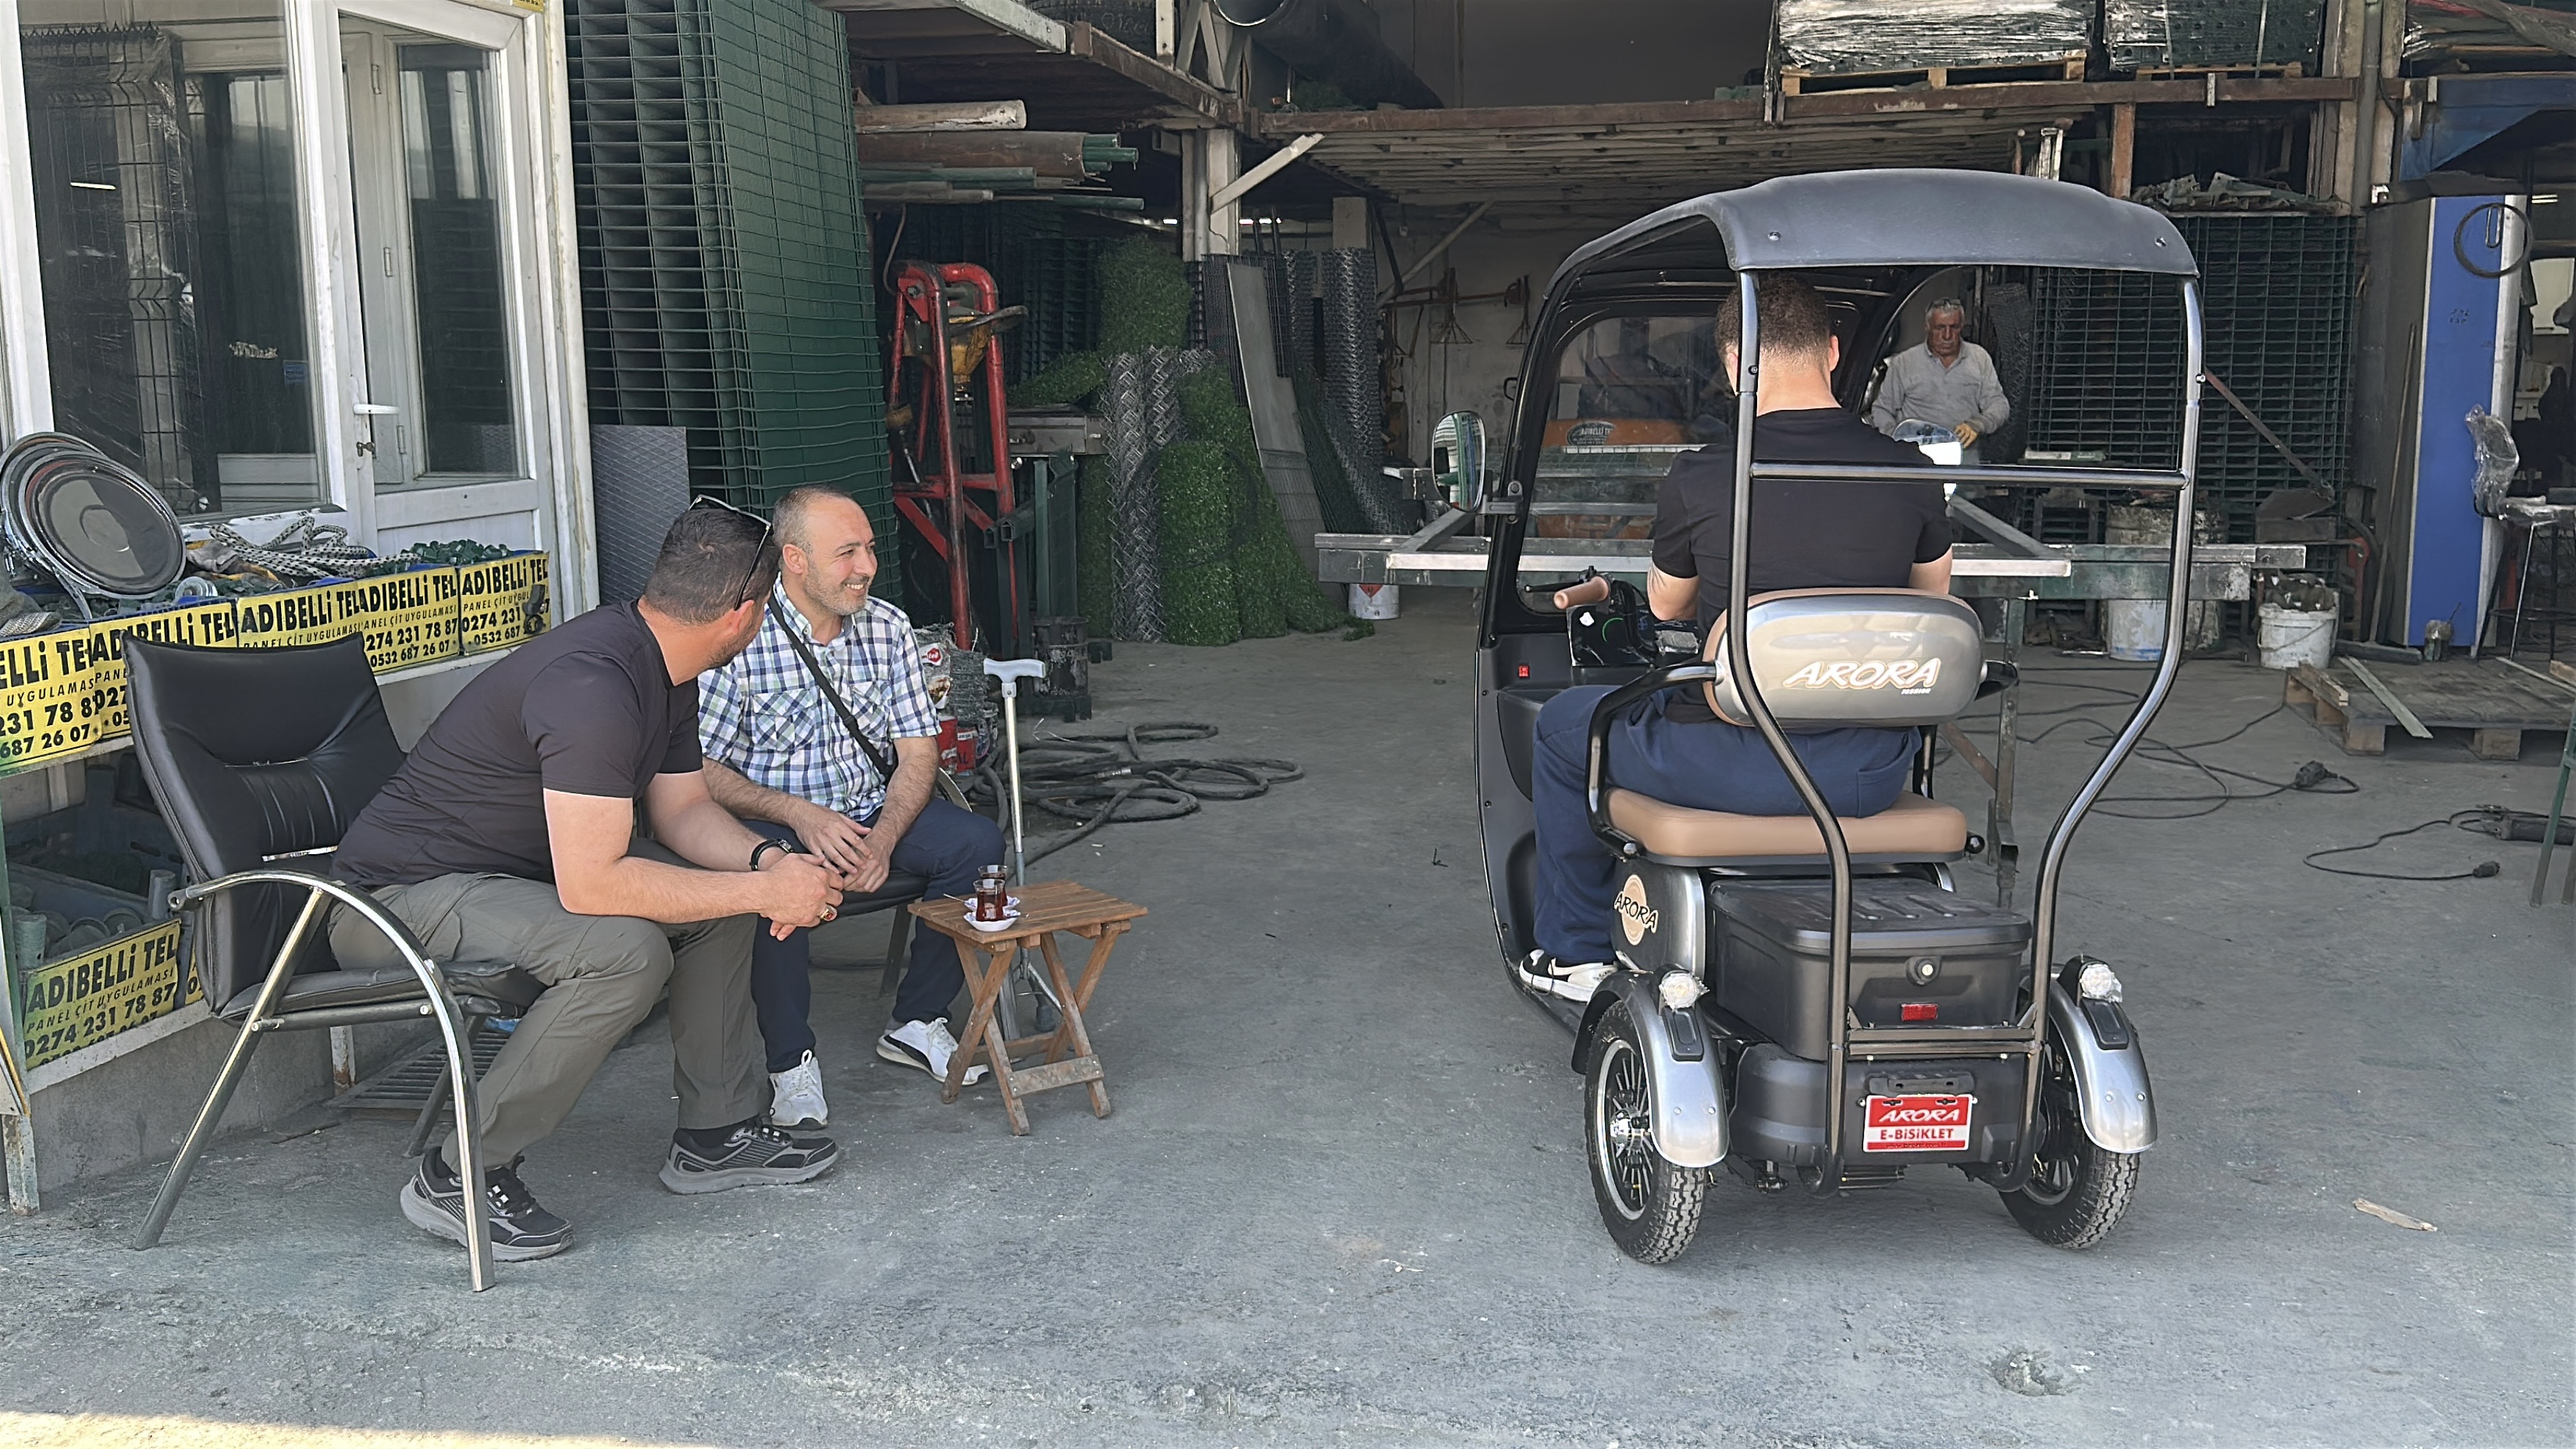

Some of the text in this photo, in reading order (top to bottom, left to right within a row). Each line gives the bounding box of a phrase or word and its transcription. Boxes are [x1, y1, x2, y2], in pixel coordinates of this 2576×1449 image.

[433, 574, 457, 602] TEL
[337, 590, 360, 621] TEL
[362, 617, 387, 630] ANEL
[405, 604, 456, 622] UYGULAMASI
[462, 612, 497, 632] 0274
[501, 607, 520, 626] 231
[463, 600, 492, 613] PANEL
[201, 612, 235, 645] TEL
[397, 626, 419, 645] 231
[425, 621, 441, 640] 78
[445, 618, 458, 635] 87
[474, 630, 502, 645] 0532
[505, 626, 520, 640] 687
[370, 639, 449, 667] 0532 687 26 07
[1783, 658, 1942, 690] ARORA
[45, 701, 73, 727] 78
[0, 723, 91, 759] 687 26 07
[1614, 892, 1658, 932] ARORA
[143, 934, 177, 971] TEL
[26, 1013, 70, 1034] PANEL
[97, 967, 174, 1009] UYGULAMASI
[25, 1024, 77, 1060] 0274
[83, 1006, 116, 1038] 231
[124, 993, 146, 1019] 78
[151, 982, 177, 1006] 87
[1879, 1109, 1960, 1123] ARORA
